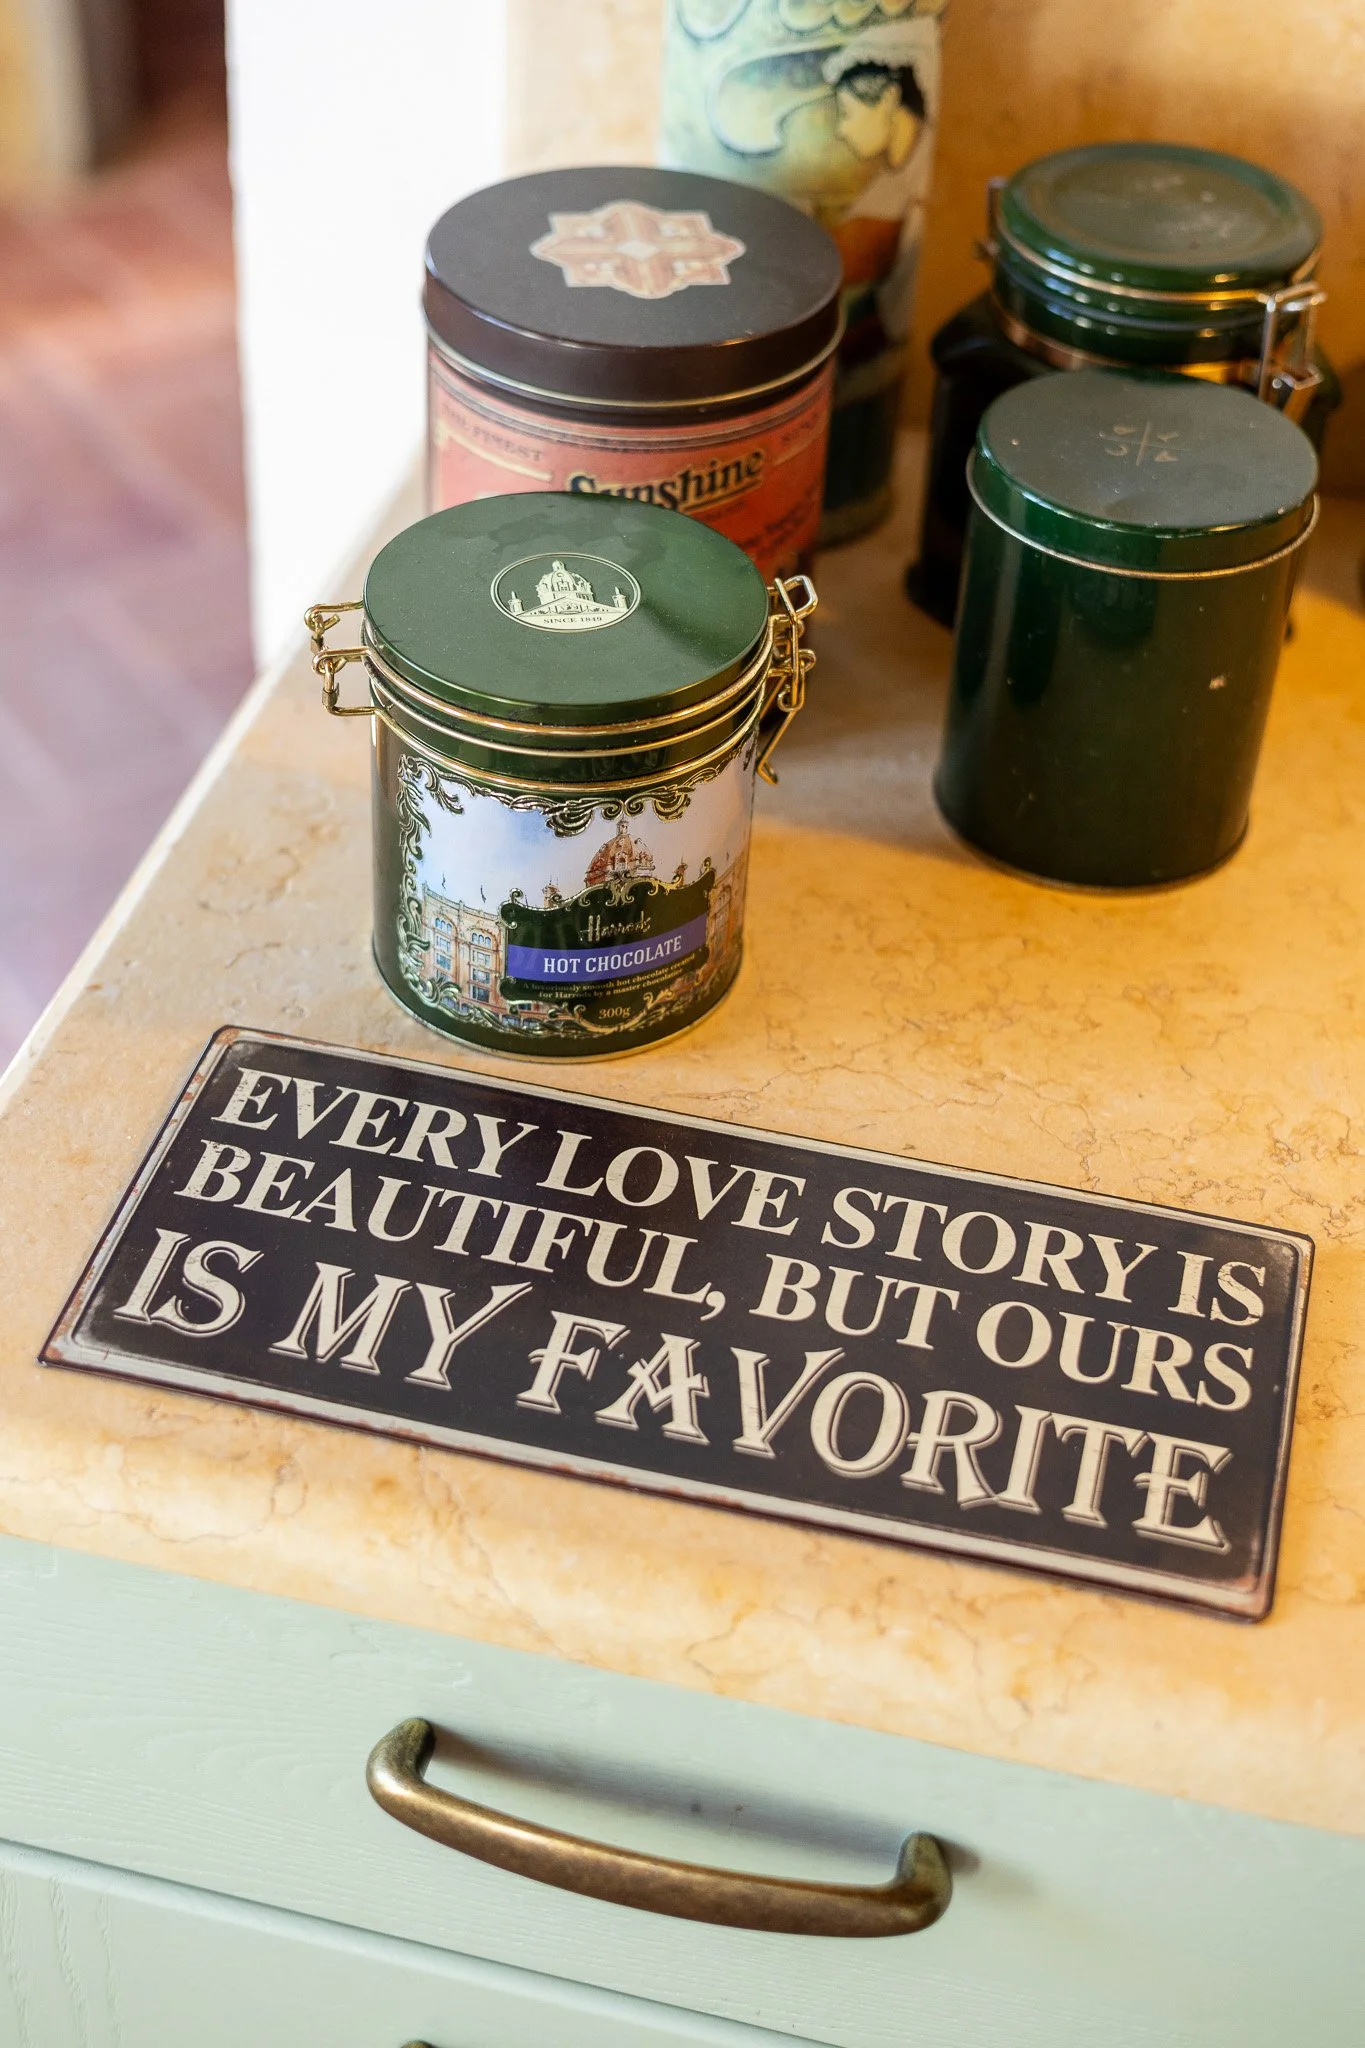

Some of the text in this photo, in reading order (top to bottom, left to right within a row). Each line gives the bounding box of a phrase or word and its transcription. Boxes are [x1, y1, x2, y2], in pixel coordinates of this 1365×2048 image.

[569, 450, 764, 511] nshine
[579, 910, 652, 943] Harrods
[543, 935, 682, 974] HOT CHOCOLATE
[582, 979, 615, 991] smooth
[616, 977, 631, 987] hot
[632, 965, 670, 984] chocolate
[670, 953, 696, 972] created
[539, 991, 553, 999] for
[555, 991, 592, 999] Harrods
[593, 989, 604, 999] by
[612, 983, 642, 996] master
[642, 967, 684, 987] chocolatier
[599, 1006, 632, 1020] 300g
[211, 1067, 1267, 1327] EVERY LOVE STORY IS
[173, 1138, 1255, 1412] BEAUTIFUL, BUT OURS
[113, 1227, 1235, 1555] IS MY FAVORITE
